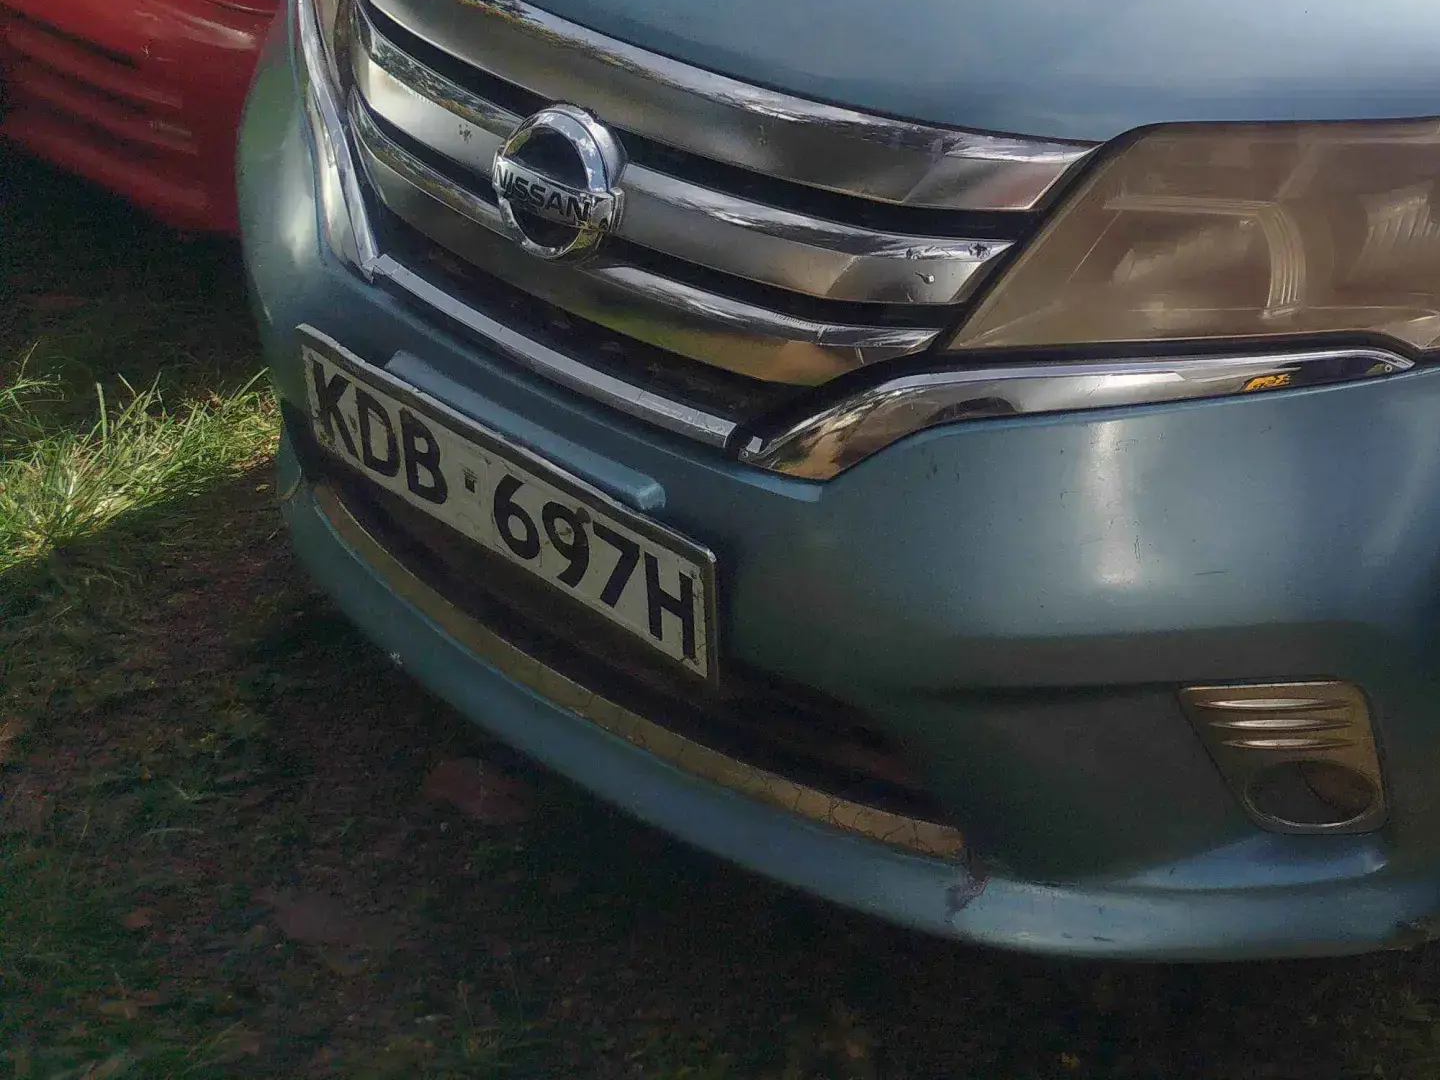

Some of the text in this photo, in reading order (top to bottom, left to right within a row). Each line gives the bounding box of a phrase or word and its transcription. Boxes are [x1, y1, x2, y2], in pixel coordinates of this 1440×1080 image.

[496, 161, 592, 222] NISSAN
[311, 361, 697, 662] KDB 697H
